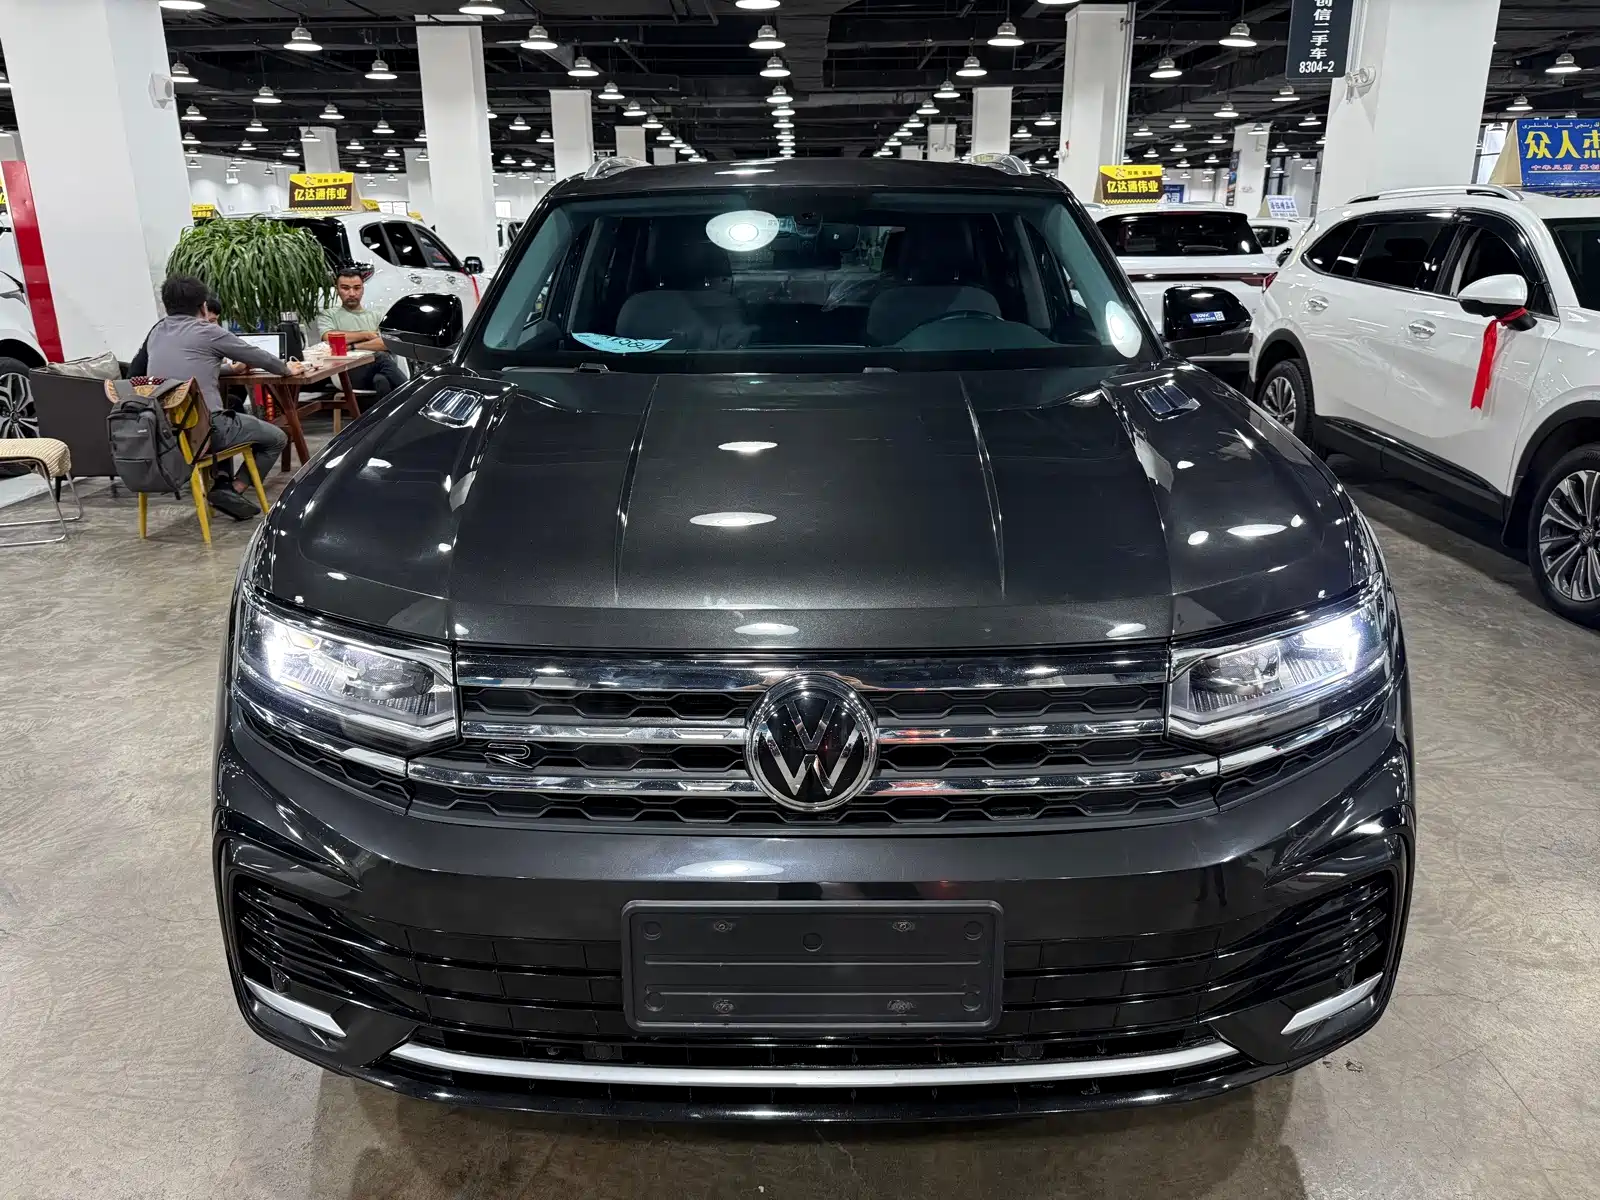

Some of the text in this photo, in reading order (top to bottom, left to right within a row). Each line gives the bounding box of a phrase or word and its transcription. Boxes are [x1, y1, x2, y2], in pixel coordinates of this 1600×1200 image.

[1299, 60, 1335, 74] 8304-2
[294, 187, 348, 201] 亿达通伟业
[1106, 180, 1159, 194] 亿达通伟业
[758, 699, 863, 797] VW
